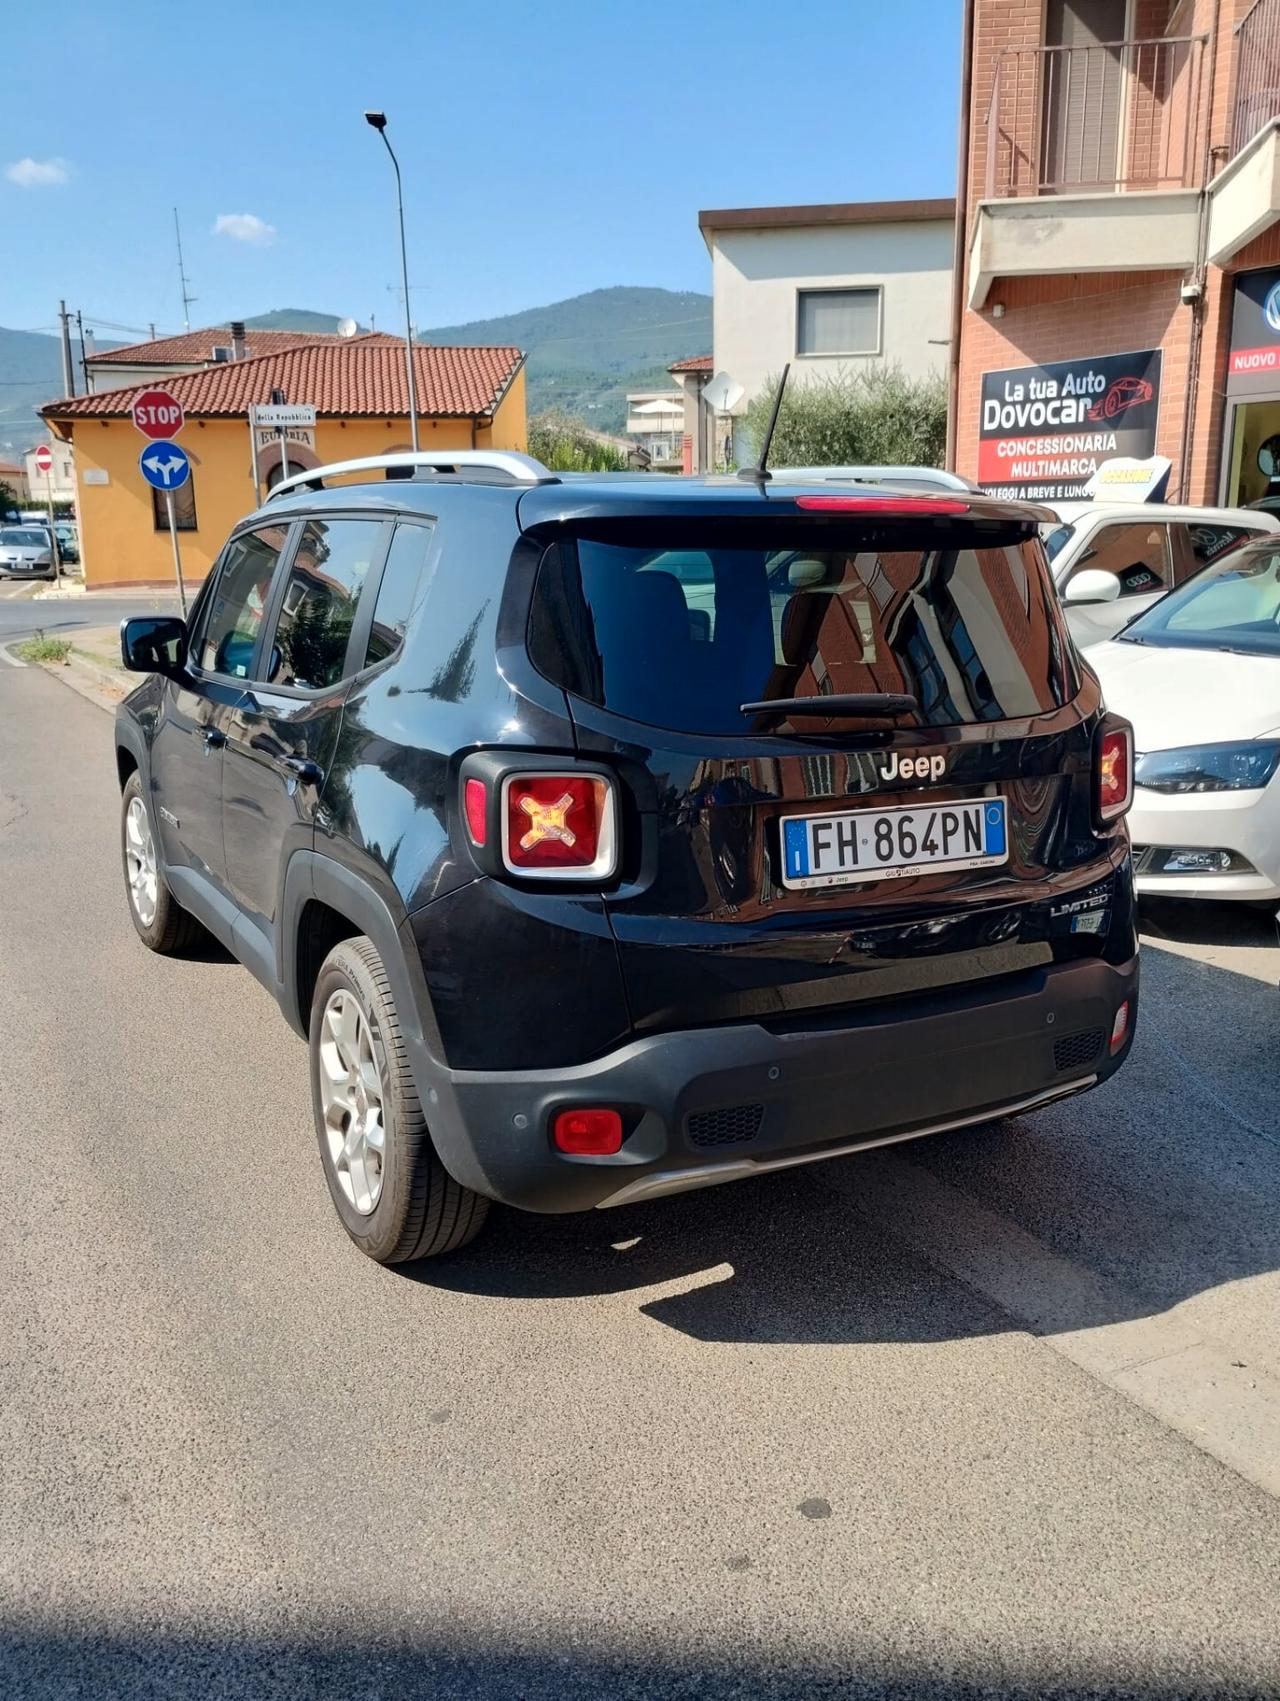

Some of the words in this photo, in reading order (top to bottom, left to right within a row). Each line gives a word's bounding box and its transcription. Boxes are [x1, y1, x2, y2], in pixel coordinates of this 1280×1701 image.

[1234, 352, 1276, 369] NUOVO
[1005, 380, 1024, 402] La
[1029, 377, 1057, 400] tua
[1061, 370, 1106, 396] Auto
[136, 406, 179, 425] STOP
[983, 397, 1092, 431] Dovocar
[997, 433, 1117, 457] CONCESSIONARIA
[1011, 458, 1097, 477] MULTIMARCA
[1019, 487, 1026, 499] A
[1027, 486, 1055, 499] BREVE
[1057, 486, 1063, 498] E
[880, 752, 946, 781] Jeep
[812, 820, 859, 869] FH
[1050, 893, 1109, 917] LIMITED
